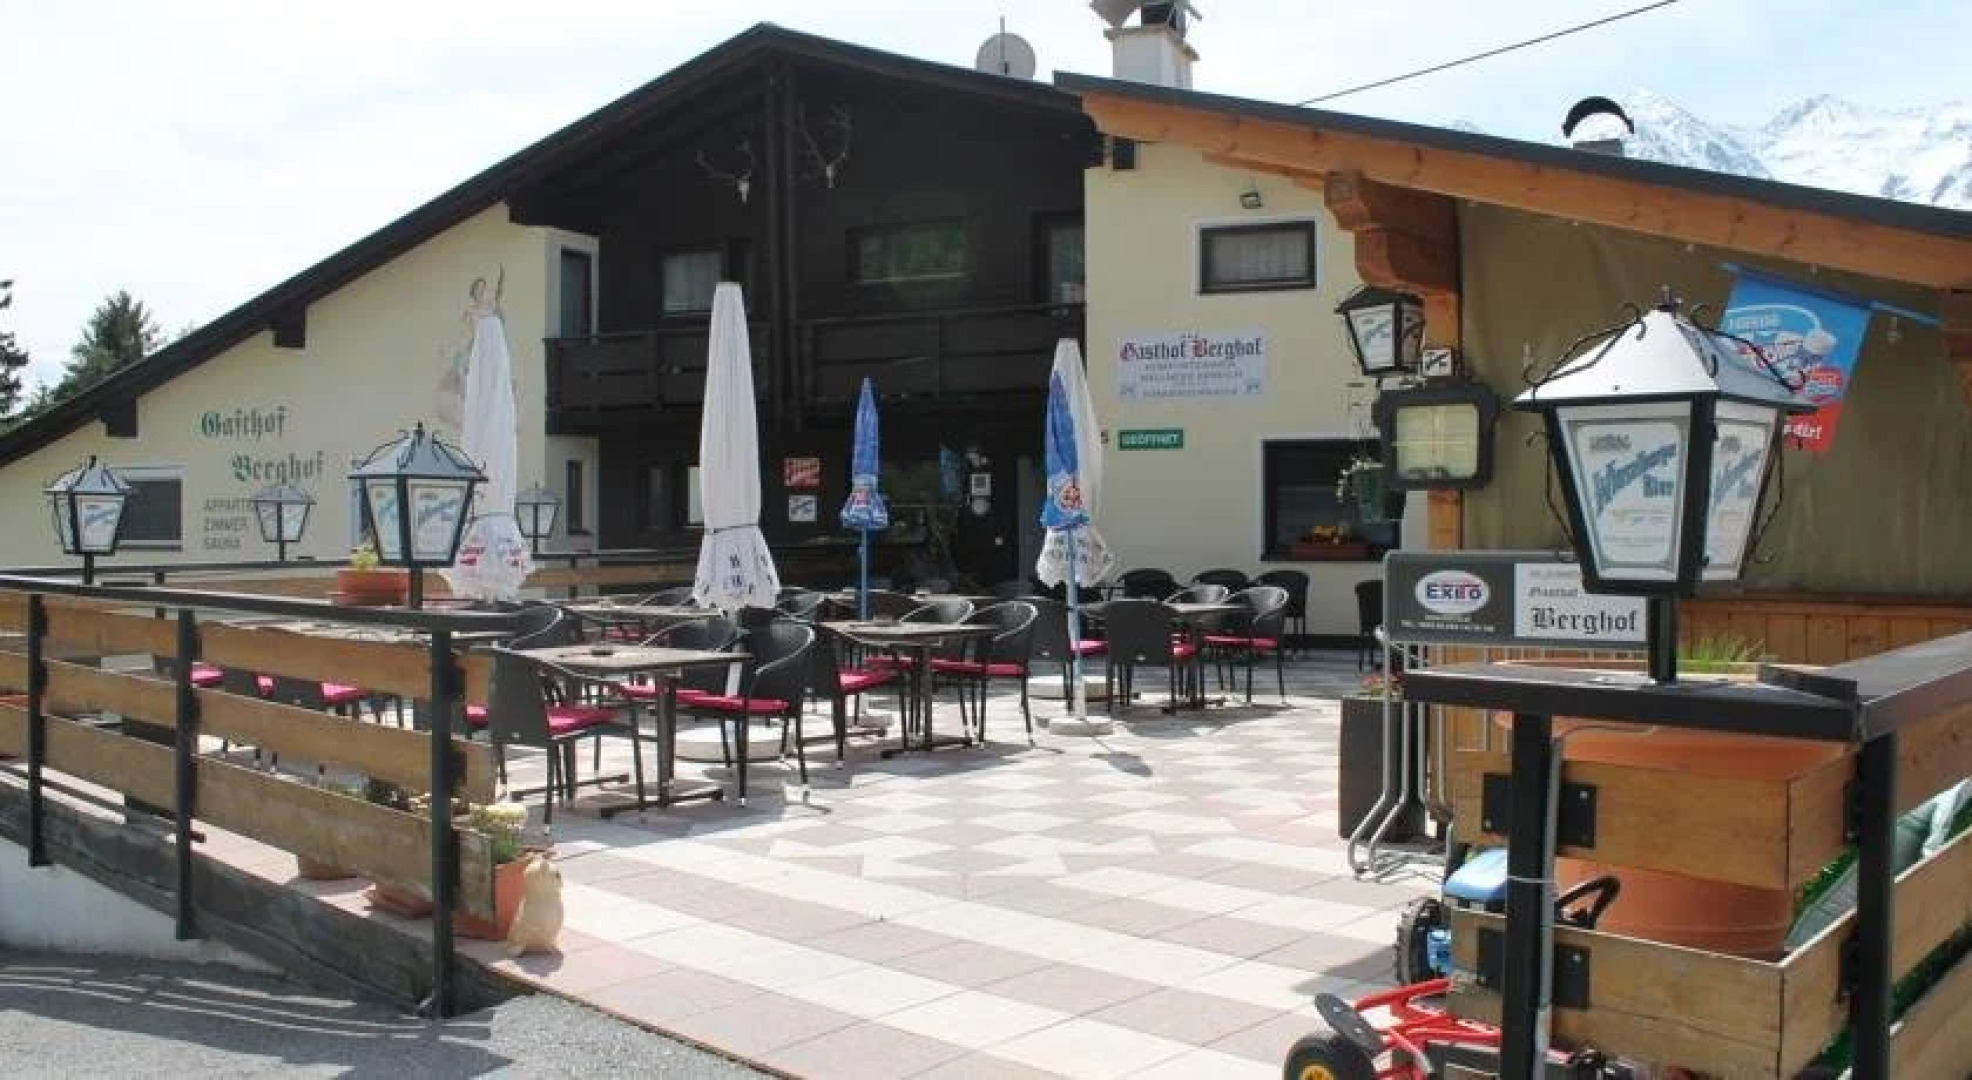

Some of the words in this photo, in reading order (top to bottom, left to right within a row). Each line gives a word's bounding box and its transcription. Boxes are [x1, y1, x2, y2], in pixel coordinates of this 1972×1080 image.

[1120, 340, 1185, 361] Gasthof
[1193, 337, 1262, 360] Berghof
[201, 406, 286, 441] Gasthof
[231, 451, 324, 484] Berghof
[1531, 607, 1638, 635] Berghof
